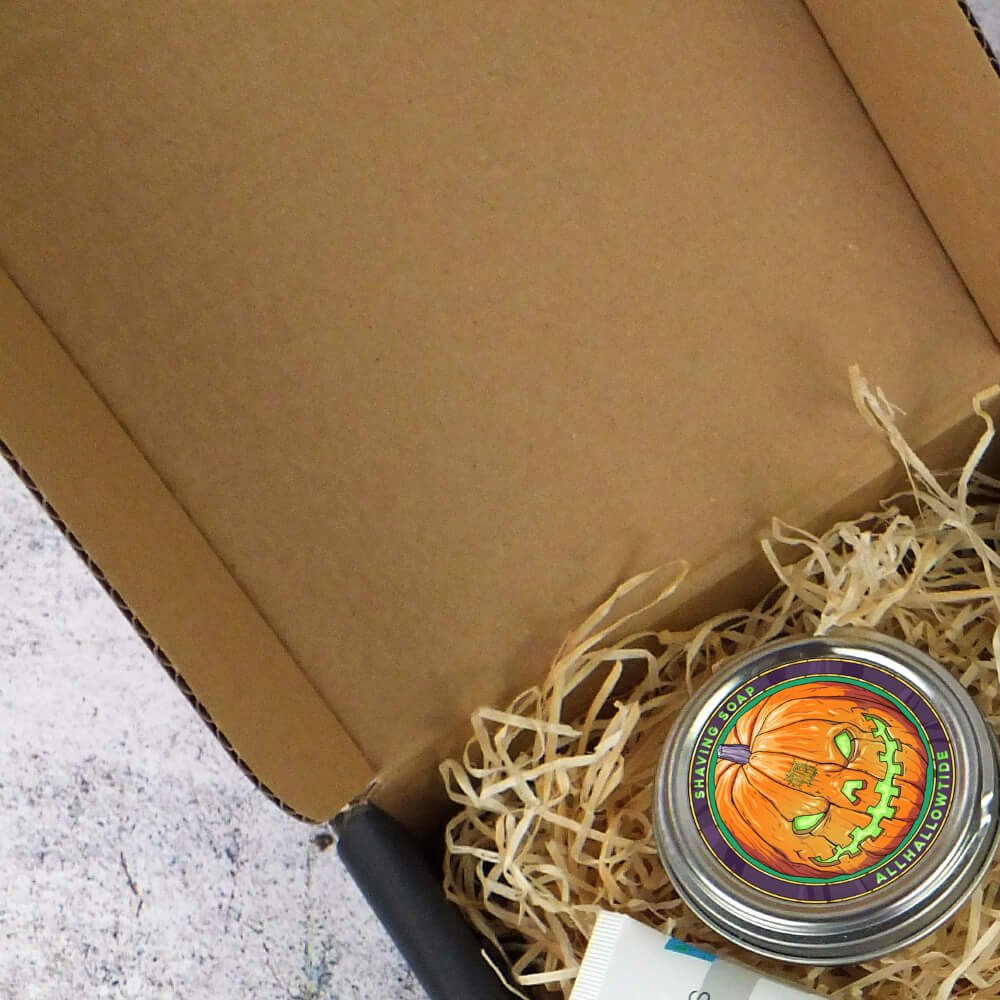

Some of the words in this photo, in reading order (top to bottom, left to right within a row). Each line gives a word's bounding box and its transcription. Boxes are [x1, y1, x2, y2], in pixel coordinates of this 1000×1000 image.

[694, 726, 719, 800] SHAVING
[717, 685, 756, 721] SOAP
[875, 749, 950, 885] ALLHALLOWTIDE
